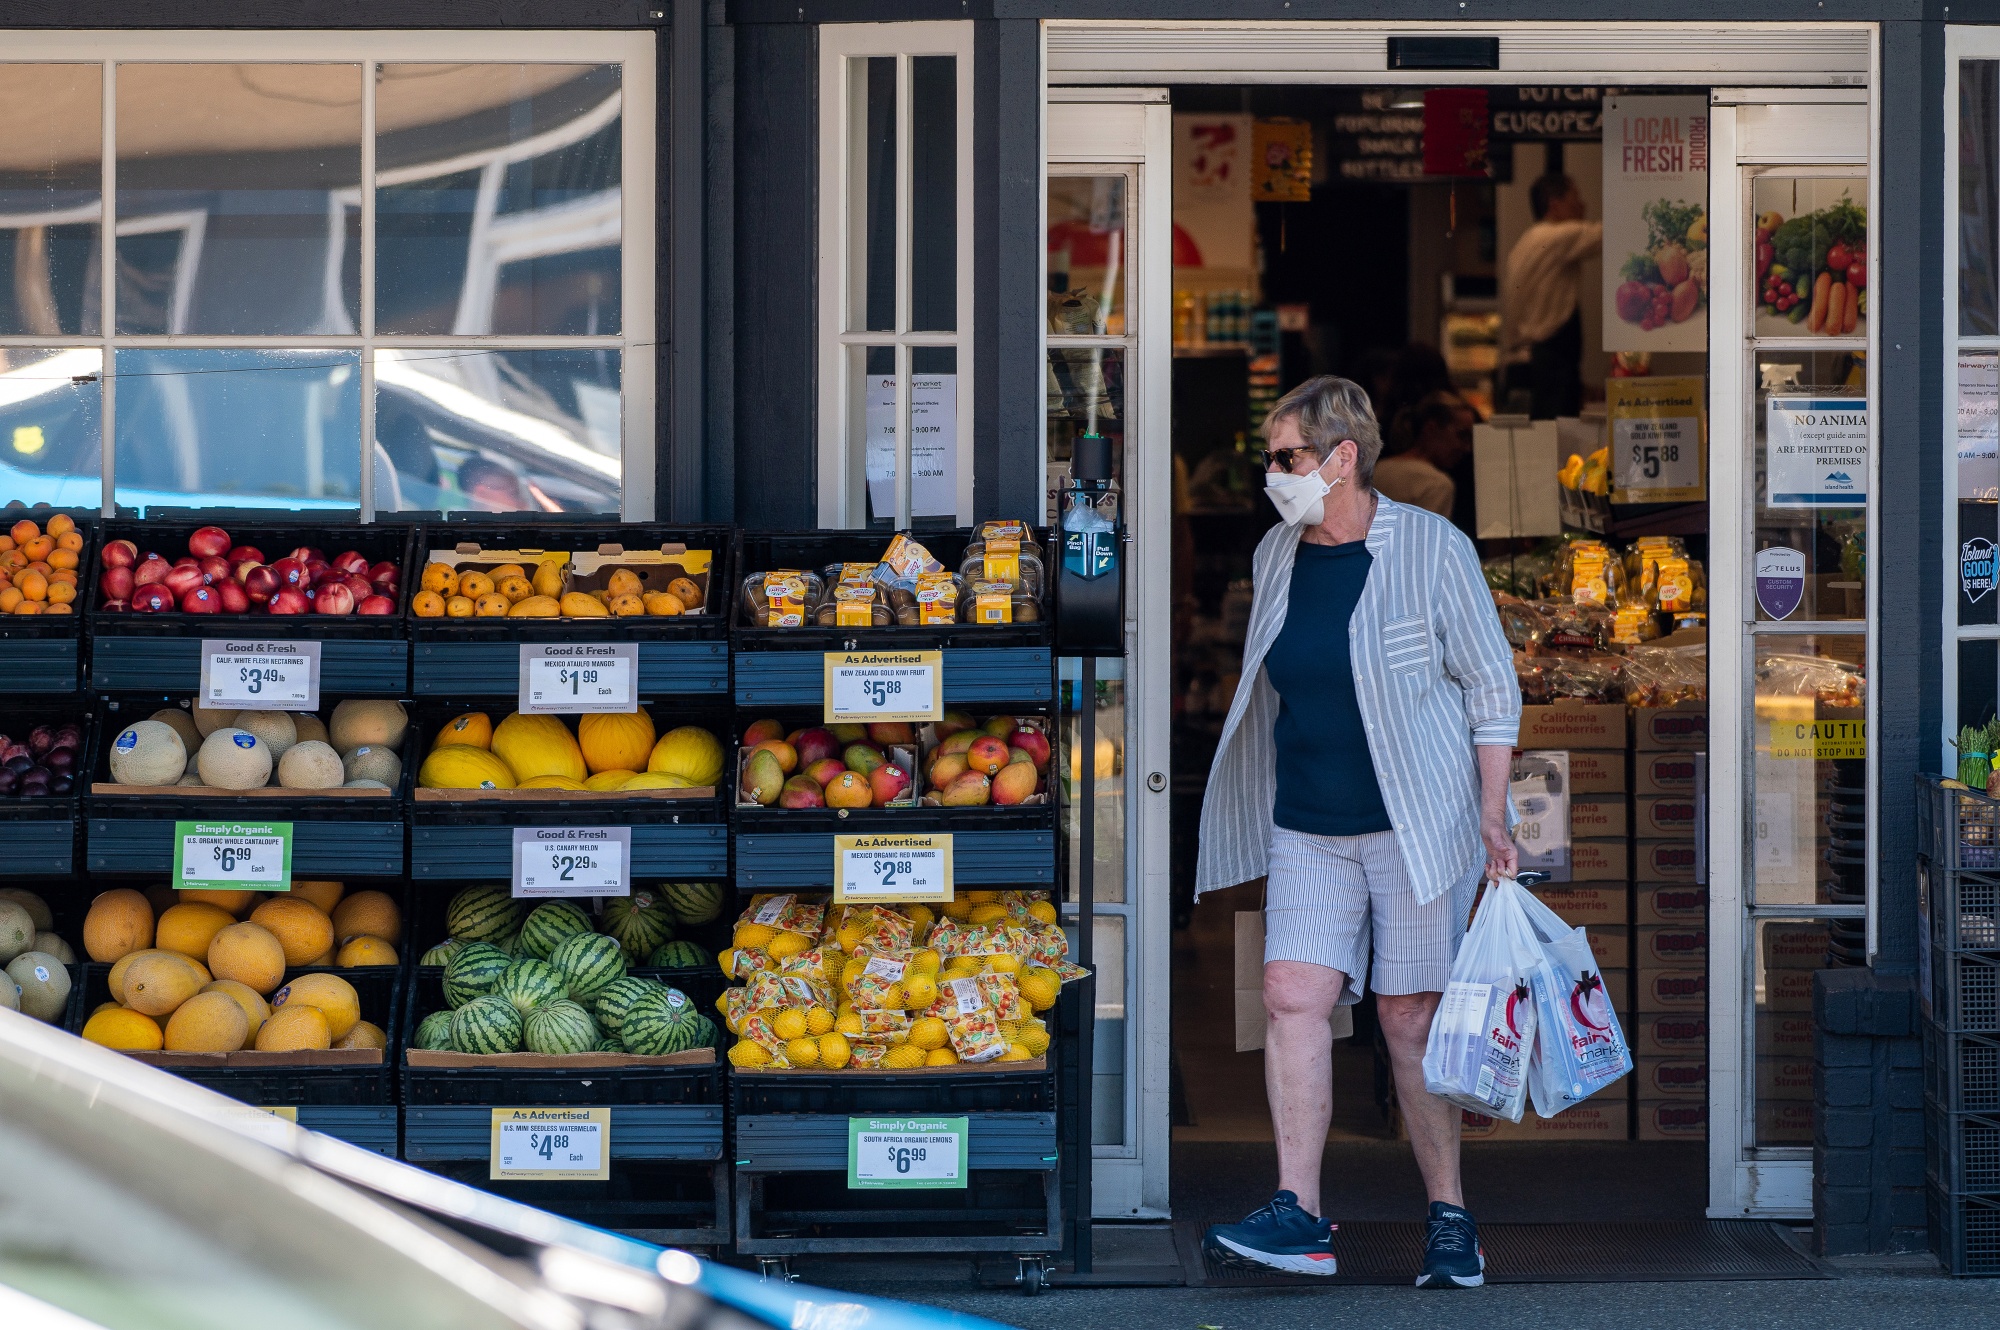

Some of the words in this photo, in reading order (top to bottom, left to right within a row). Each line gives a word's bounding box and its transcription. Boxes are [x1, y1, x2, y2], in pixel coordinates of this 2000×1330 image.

[1493, 110, 1603, 135] EUROPEA
[1622, 116, 1685, 145] LOCAL
[1689, 115, 1706, 173] PRODUCE
[1622, 145, 1683, 173] FRESH
[1957, 362, 1999, 370] fairwayma
[1617, 398, 1632, 407] As
[1634, 396, 1693, 407] Advertised
[1795, 415, 1816, 426] NO
[1819, 415, 1867, 427] ANIMA
[1634, 423, 1648, 431] NEW
[1650, 423, 1677, 431] ZEALAND
[1630, 432, 1646, 440] GOLD
[1663, 431, 1681, 439] FRUIT
[1799, 432, 1825, 441] (except
[1826, 432, 1846, 441] guide
[1847, 432, 1866, 440] anim
[1776, 446, 1796, 455] ARE
[1797, 446, 1852, 455] PERMITTED
[1816, 457, 1862, 466] PREMISES
[1962, 544, 1993, 562] Island
[1964, 560, 1991, 578] GOOD
[1965, 578, 1971, 590] IS
[1972, 578, 1991, 589] HERE!
[1558, 635, 1590, 645] CHERRIES
[226, 643, 253, 653] Good
[255, 643, 265, 653] &
[267, 643, 297, 654] Fresh
[545, 646, 573, 655] Good
[575, 646, 584, 655] &
[586, 646, 616, 655] Fresh
[216, 657, 233, 665] CALIF.
[270, 658, 303, 666] NECTARINES
[544, 660, 566, 668] MEXICO
[566, 660, 590, 668] ATAULFO
[591, 660, 615, 668] MANGOS
[845, 655, 860, 664] As
[861, 654, 921, 664] Advertised
[895, 669, 909, 677] KIWI
[598, 687, 612, 695] Each
[1540, 712, 1597, 724] California
[1531, 723, 1606, 735] Strawberries
[1795, 723, 1866, 739] CAUTI
[1777, 748, 1790, 757] DO
[1794, 748, 1813, 757] NOT
[1817, 748, 1841, 757] STOP
[1845, 747, 1855, 756] IN
[195, 824, 231, 835] Simply
[232, 825, 273, 835] Organic
[536, 830, 565, 839] Good
[567, 830, 576, 839] &
[578, 829, 608, 839] Fresh
[187, 837, 198, 845] U.S.
[199, 837, 224, 845] ORGANIC
[245, 838, 279, 846] CANTALOUPE
[855, 838, 870, 847] As
[871, 838, 932, 847] Advertised
[912, 877, 927, 885] Each
[1541, 888, 1599, 900] California
[513, 1111, 527, 1120] As
[529, 1111, 590, 1120] Advertised
[869, 1120, 906, 1131] Simply
[907, 1121, 948, 1131] Organic
[1535, 1119, 1609, 1131] Strawberries
[569, 1153, 584, 1161] Each
